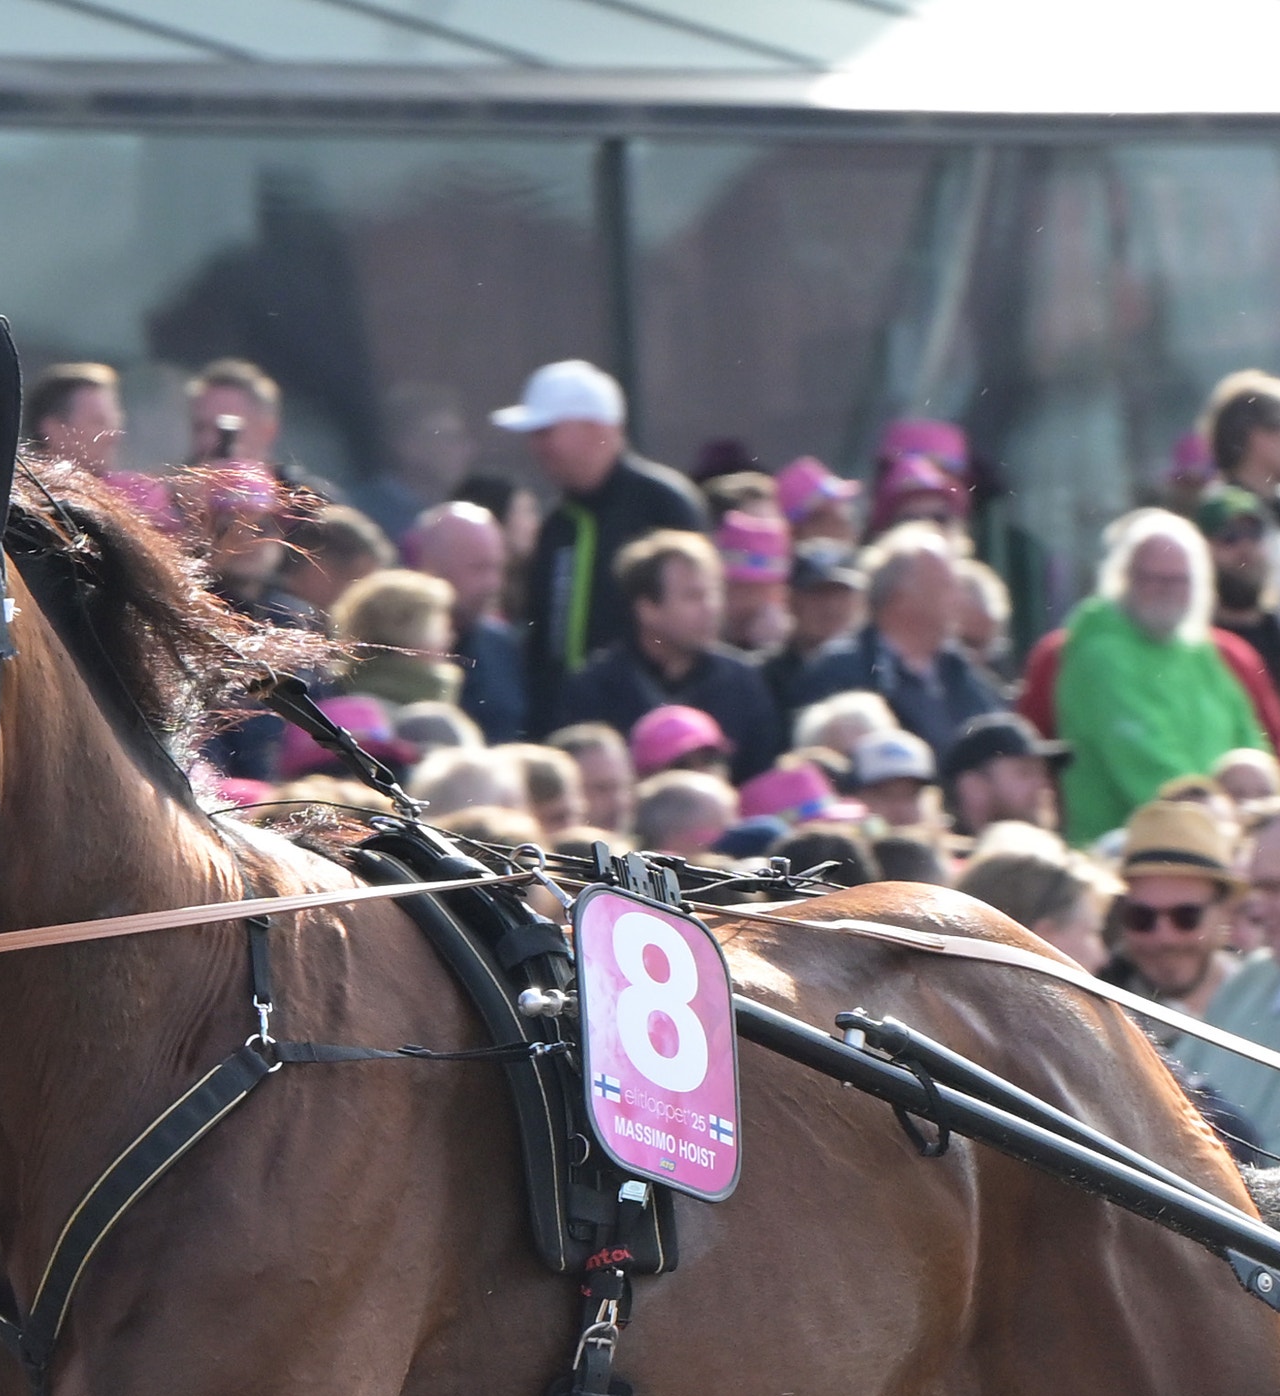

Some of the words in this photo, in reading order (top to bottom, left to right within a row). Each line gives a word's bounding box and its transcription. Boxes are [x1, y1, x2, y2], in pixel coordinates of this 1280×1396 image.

[612, 911, 709, 1093] 8
[614, 1114, 676, 1155] MASSIMO
[679, 1138, 716, 1170] HOIST
